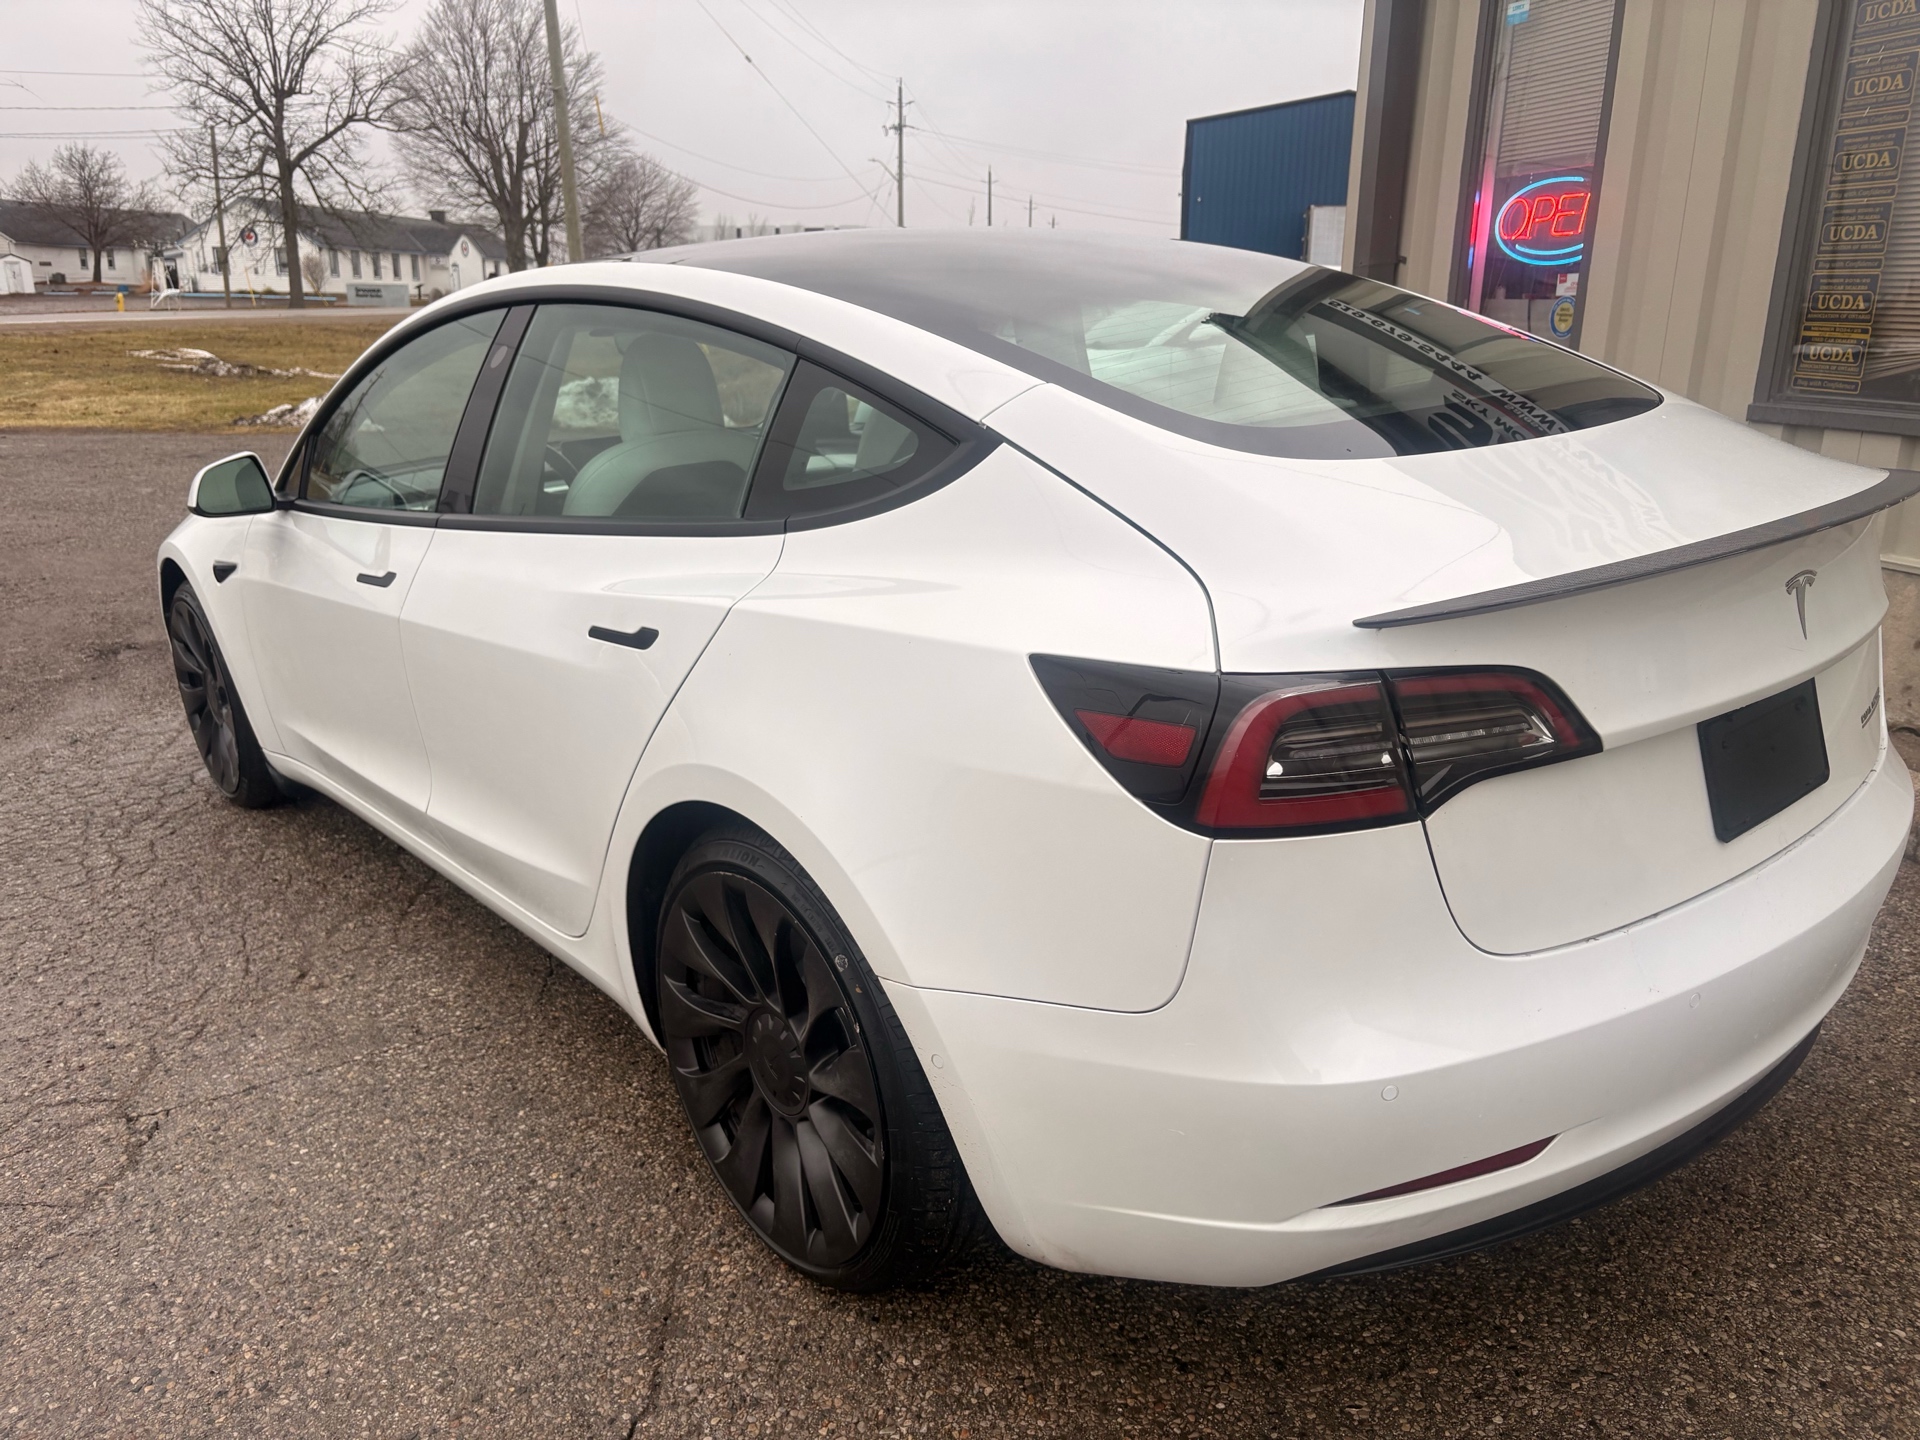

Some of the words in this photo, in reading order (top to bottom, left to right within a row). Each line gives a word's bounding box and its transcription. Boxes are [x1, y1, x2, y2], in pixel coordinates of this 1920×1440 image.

[1865, 0, 1917, 22] UCDA
[1853, 73, 1904, 96] UCDA
[1841, 151, 1891, 170] UCDA
[1829, 224, 1878, 241] UCDA
[1845, 258, 1879, 268] Confidence
[1817, 294, 1866, 310] UCDA
[1809, 345, 1854, 362] UCDA
[1823, 380, 1856, 390] Confidence
